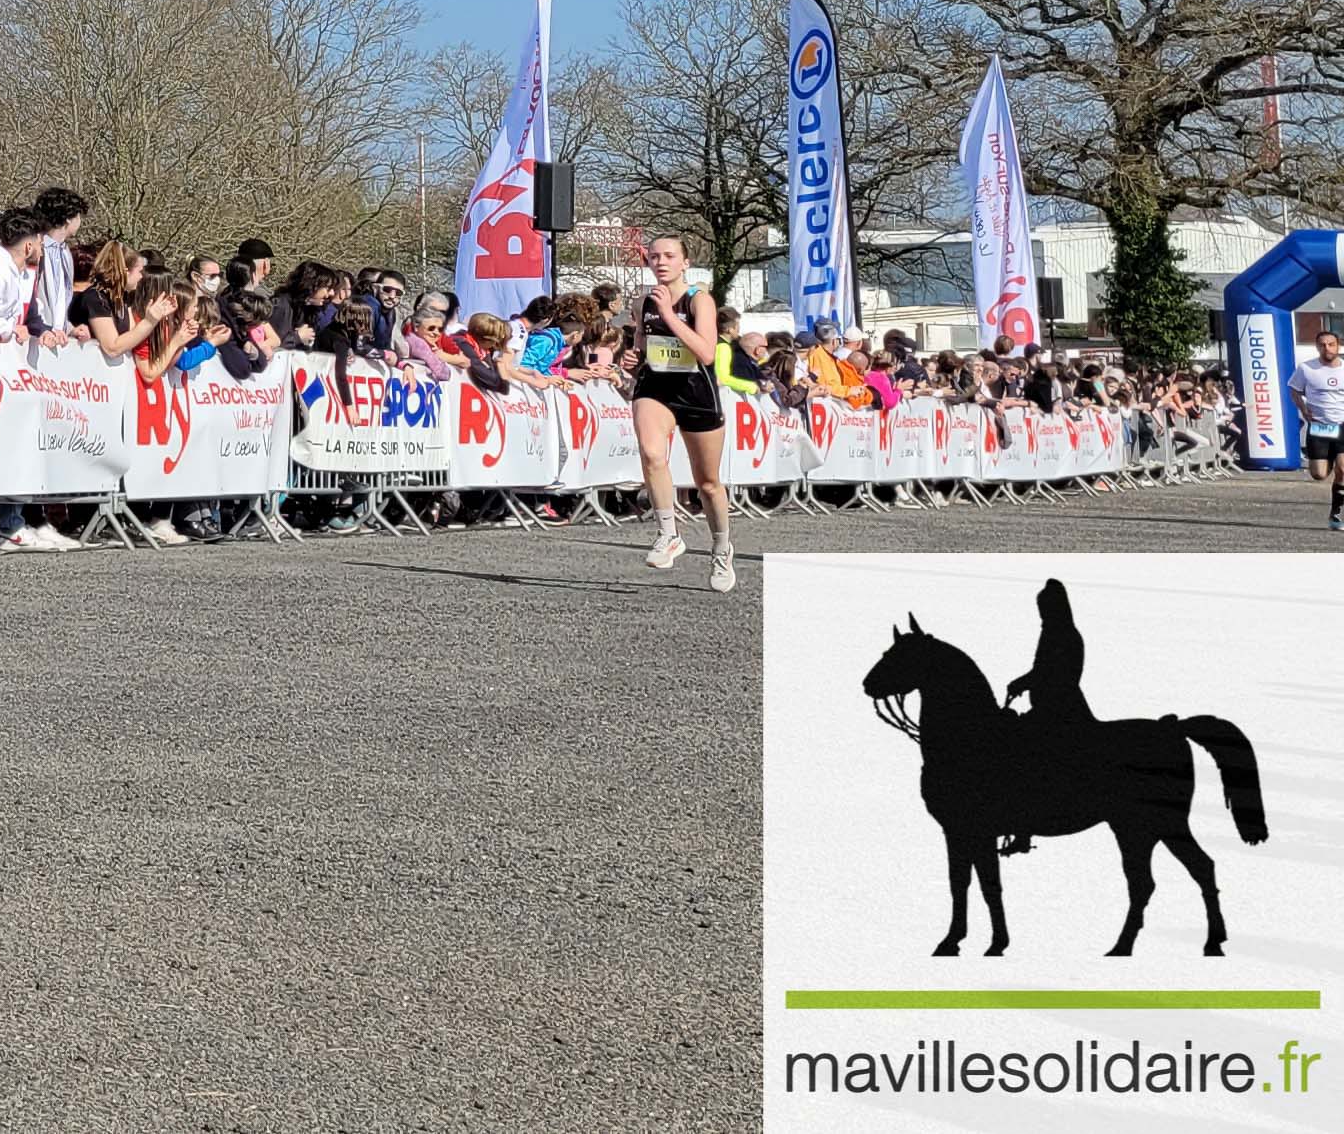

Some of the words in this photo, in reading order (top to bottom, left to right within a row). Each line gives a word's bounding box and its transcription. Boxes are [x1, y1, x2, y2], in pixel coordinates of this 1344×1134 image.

[1247, 326, 1274, 431] INTERSPORT
[326, 439, 342, 453] LA
[381, 441, 399, 456] SUR
